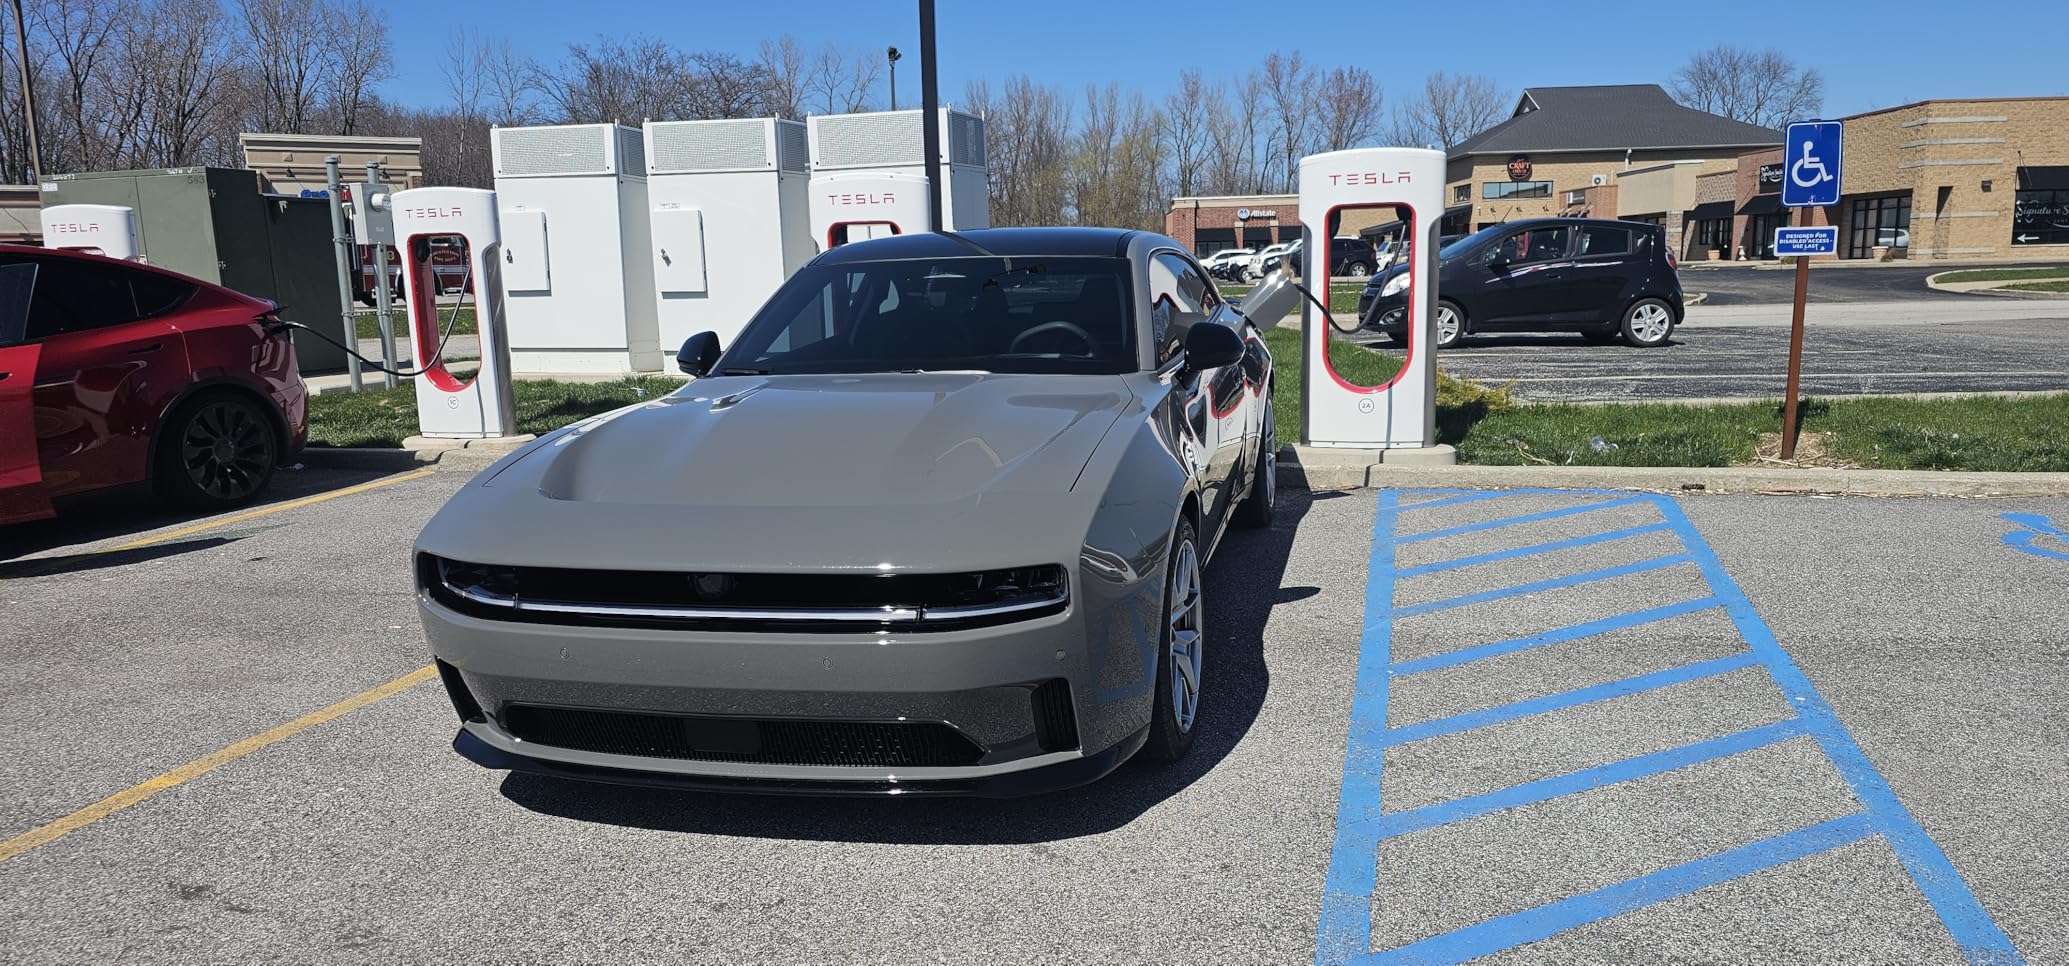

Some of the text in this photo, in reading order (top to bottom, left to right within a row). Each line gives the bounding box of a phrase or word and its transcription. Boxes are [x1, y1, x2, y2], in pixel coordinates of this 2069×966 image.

[1328, 171, 1411, 186] TESLA
[827, 193, 895, 206] TESLA
[405, 207, 462, 219] TESLA
[51, 223, 99, 233] TESLA
